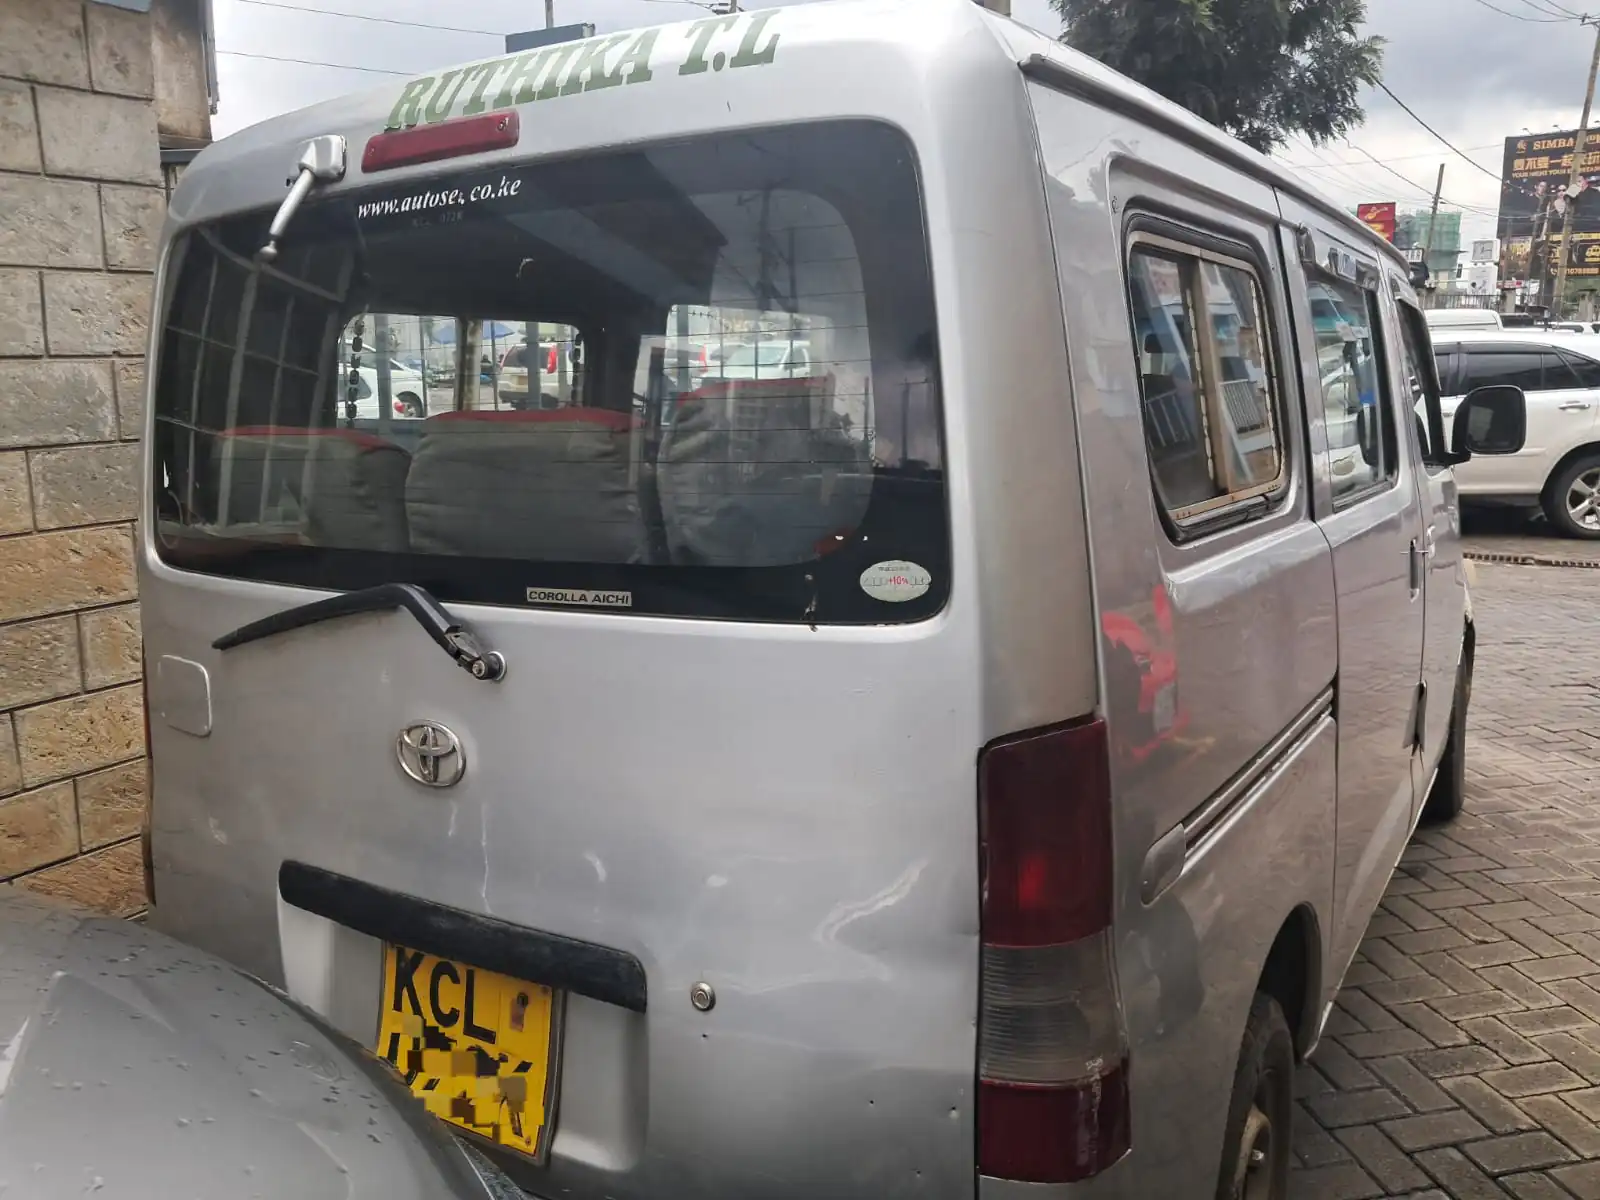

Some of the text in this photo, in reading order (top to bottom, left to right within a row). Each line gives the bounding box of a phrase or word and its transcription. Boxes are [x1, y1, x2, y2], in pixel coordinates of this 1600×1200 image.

[384, 9, 782, 132] RUTHIKA T.L
[1533, 137, 1575, 151] SIMBA
[529, 590, 629, 605] COROLLA AICHI
[392, 946, 497, 1045] KCL
